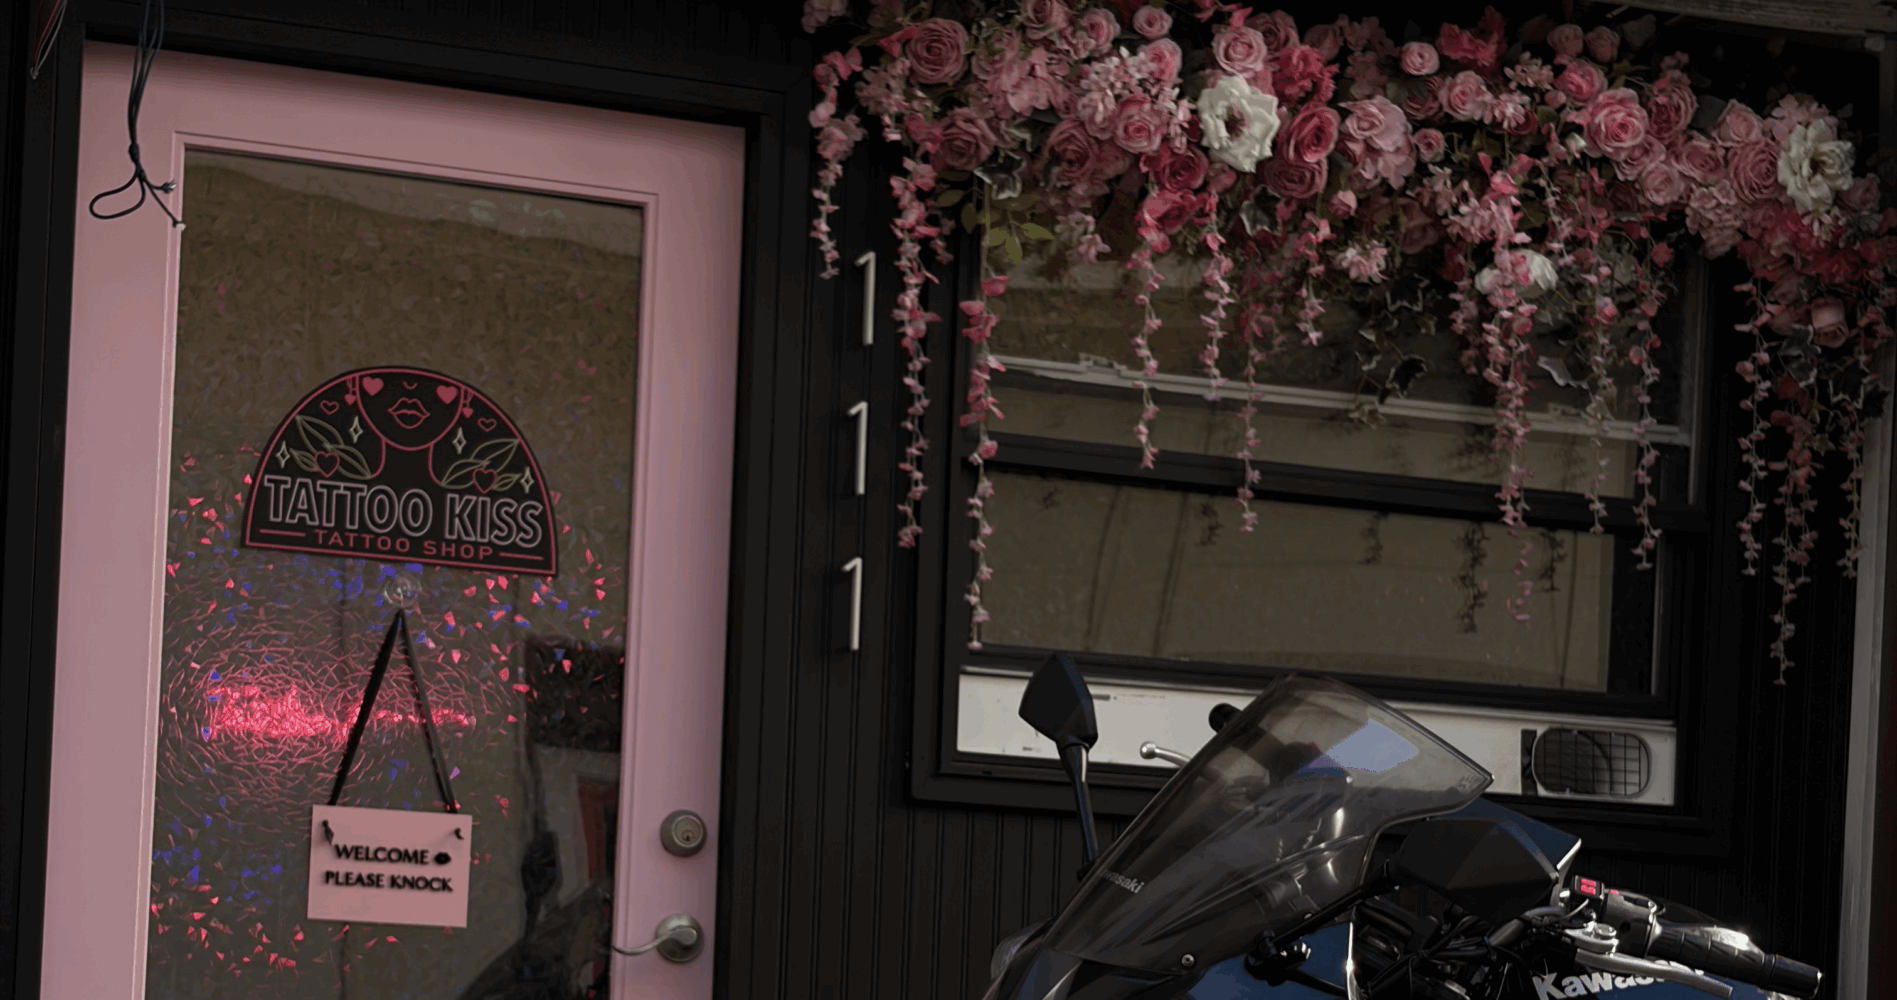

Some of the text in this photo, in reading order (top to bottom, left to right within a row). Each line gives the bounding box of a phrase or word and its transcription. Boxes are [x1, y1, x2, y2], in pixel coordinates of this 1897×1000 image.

[264, 474, 543, 548] TATTOO KISS
[314, 529, 493, 560] TATTOO SHOP
[334, 844, 430, 865] WELCOME
[324, 870, 454, 893] PLEASE KNOCK
